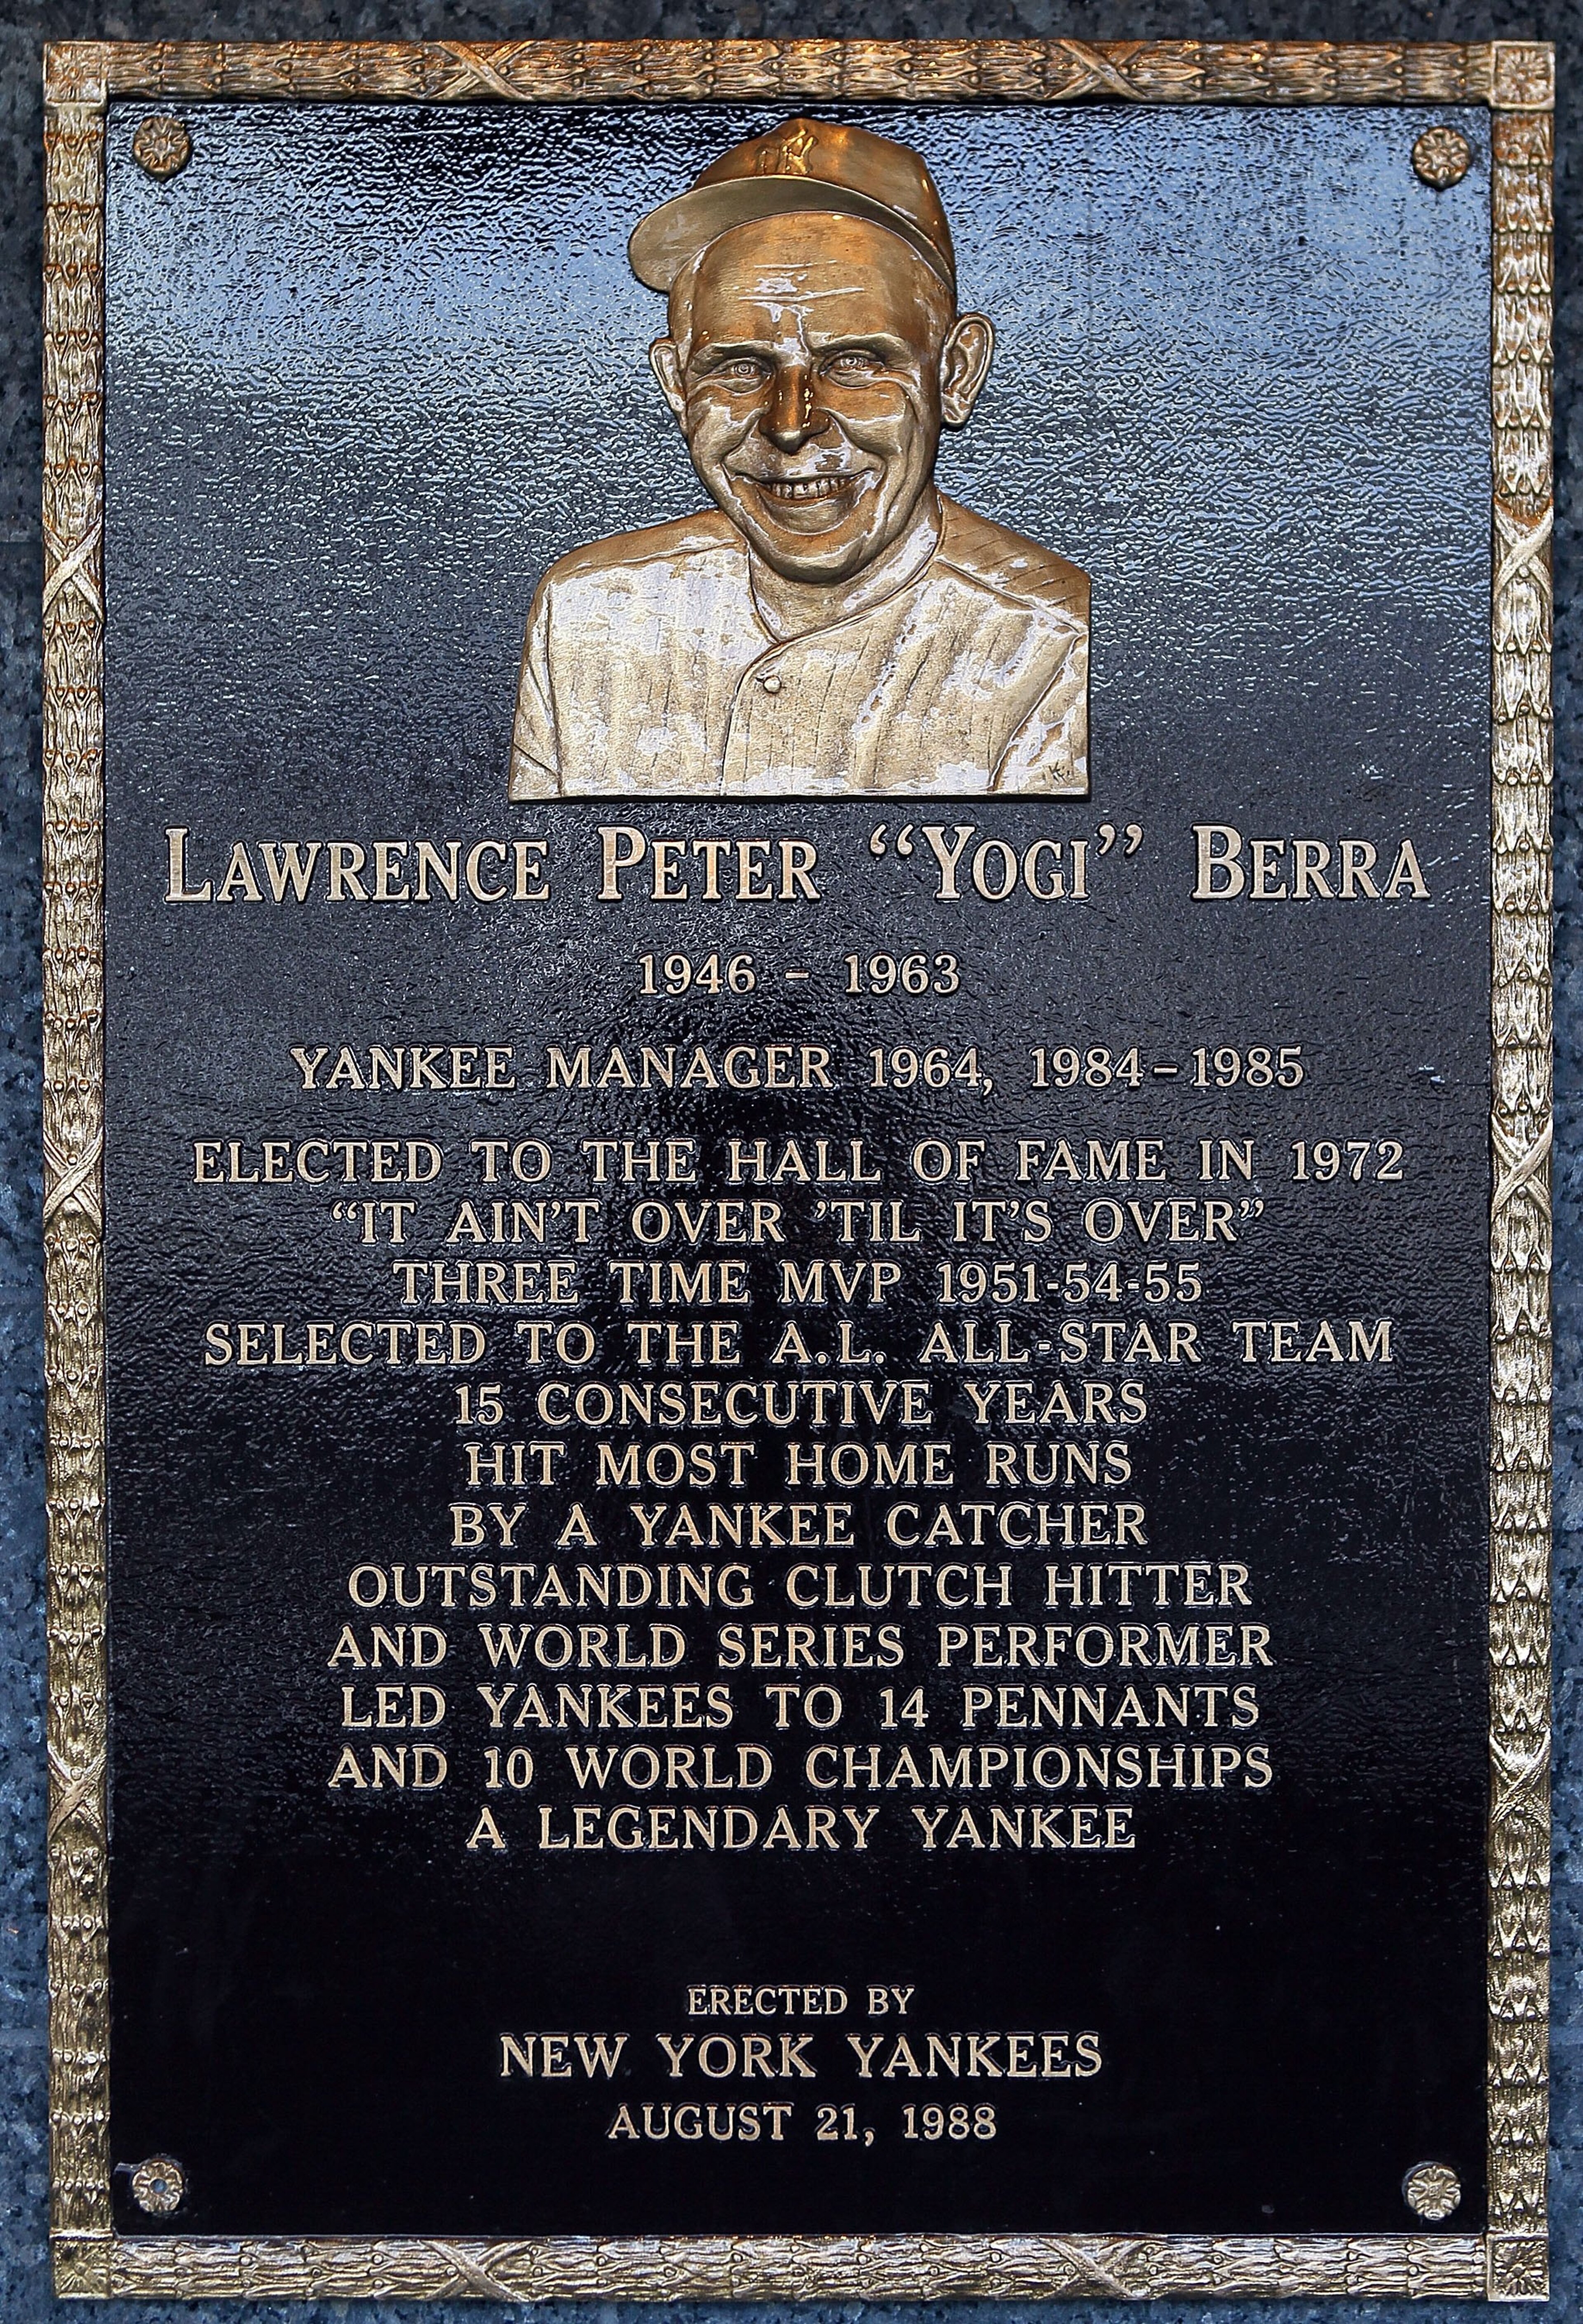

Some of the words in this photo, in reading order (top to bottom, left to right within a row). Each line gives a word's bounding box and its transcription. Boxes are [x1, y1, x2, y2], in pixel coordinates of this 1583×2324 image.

[165, 828, 550, 902] LAWRENCE
[597, 826, 821, 900] PETER
[869, 823, 1143, 900] “YOGI”
[1192, 825, 1428, 899] BERRA
[639, 953, 756, 994] 1946
[844, 954, 959, 994] 1963
[290, 1046, 516, 1090] YANKEE
[546, 1044, 834, 1089] MANAGER
[869, 1047, 993, 1095] 1964,
[193, 1141, 442, 1183] ELECTED
[470, 1140, 551, 1183] TO
[582, 1137, 696, 1182] THE
[728, 1137, 881, 1182] HALL
[913, 1137, 985, 1182] OF
[1017, 1139, 1167, 1181] FAME
[1199, 1140, 1254, 1180] IN
[1292, 1140, 1403, 1181] 1972
[332, 1201, 415, 1243] “IT
[447, 1199, 599, 1243] AIN’T
[631, 1198, 784, 1243] OVER
[816, 1200, 921, 1242] ’TIL
[954, 1200, 1052, 1243] IT’S
[1084, 1199, 1264, 1242] OVER”
[392, 1261, 578, 1304] THREE
[608, 1259, 749, 1304] TIME
[781, 1259, 902, 1304] MVP
[939, 1261, 1202, 1303] 1951-54-55
[204, 1323, 486, 1366] SELECTED
[517, 1322, 595, 1365] TO
[627, 1320, 740, 1364] THE
[772, 1322, 885, 1365] A.L.
[920, 1322, 1201, 1363] ALL-STAR
[1232, 1320, 1391, 1363] TEAM
[456, 1384, 504, 1425] 15
[536, 1379, 932, 1426] CONSECUTIVE
[963, 1382, 1147, 1424] YEARS
[466, 1442, 565, 1486] HIT
[596, 1441, 755, 1486] MOST
[787, 1441, 954, 1486] HOME
[986, 1442, 1132, 1485] RUNS
[449, 1505, 526, 1547] BY
[557, 1503, 597, 1546] A
[629, 1502, 855, 1546] YANKEE
[886, 1503, 1146, 1546] CATCHER
[348, 1562, 754, 1608] OUTSTANDING
[786, 1564, 1011, 1608] CLUTCH
[1045, 1564, 1251, 1606] HITTER
[326, 1625, 447, 1667] AND
[479, 1623, 686, 1668] WORLD
[718, 1623, 904, 1668] SERIES
[938, 1625, 1273, 1667] PERFORMER
[341, 1686, 446, 1728] LED
[477, 1683, 733, 1728] YANKEES
[765, 1683, 843, 1728] TO
[880, 1688, 928, 1728] 14
[962, 1685, 1259, 1727] PENNANTS
[328, 1746, 448, 1789] AND
[484, 1747, 534, 1789] 10
[565, 1746, 773, 1789] WORLD
[805, 1745, 1273, 1789] CHAMPIONSHIPS
[466, 1806, 506, 1849] A
[538, 1805, 880, 1850] LEGENDARY
[911, 1807, 1136, 1849] YANKEE
[688, 1984, 848, 2015] ERECTED
[867, 1987, 915, 2015] BY
[500, 2036, 628, 2078] NEW
[657, 2036, 816, 2078] YORK
[847, 2034, 1102, 2078] YANKEES
[608, 2105, 792, 2141] AUGUST
[816, 2107, 874, 2146] 21,
[903, 2106, 997, 2140] 1988
